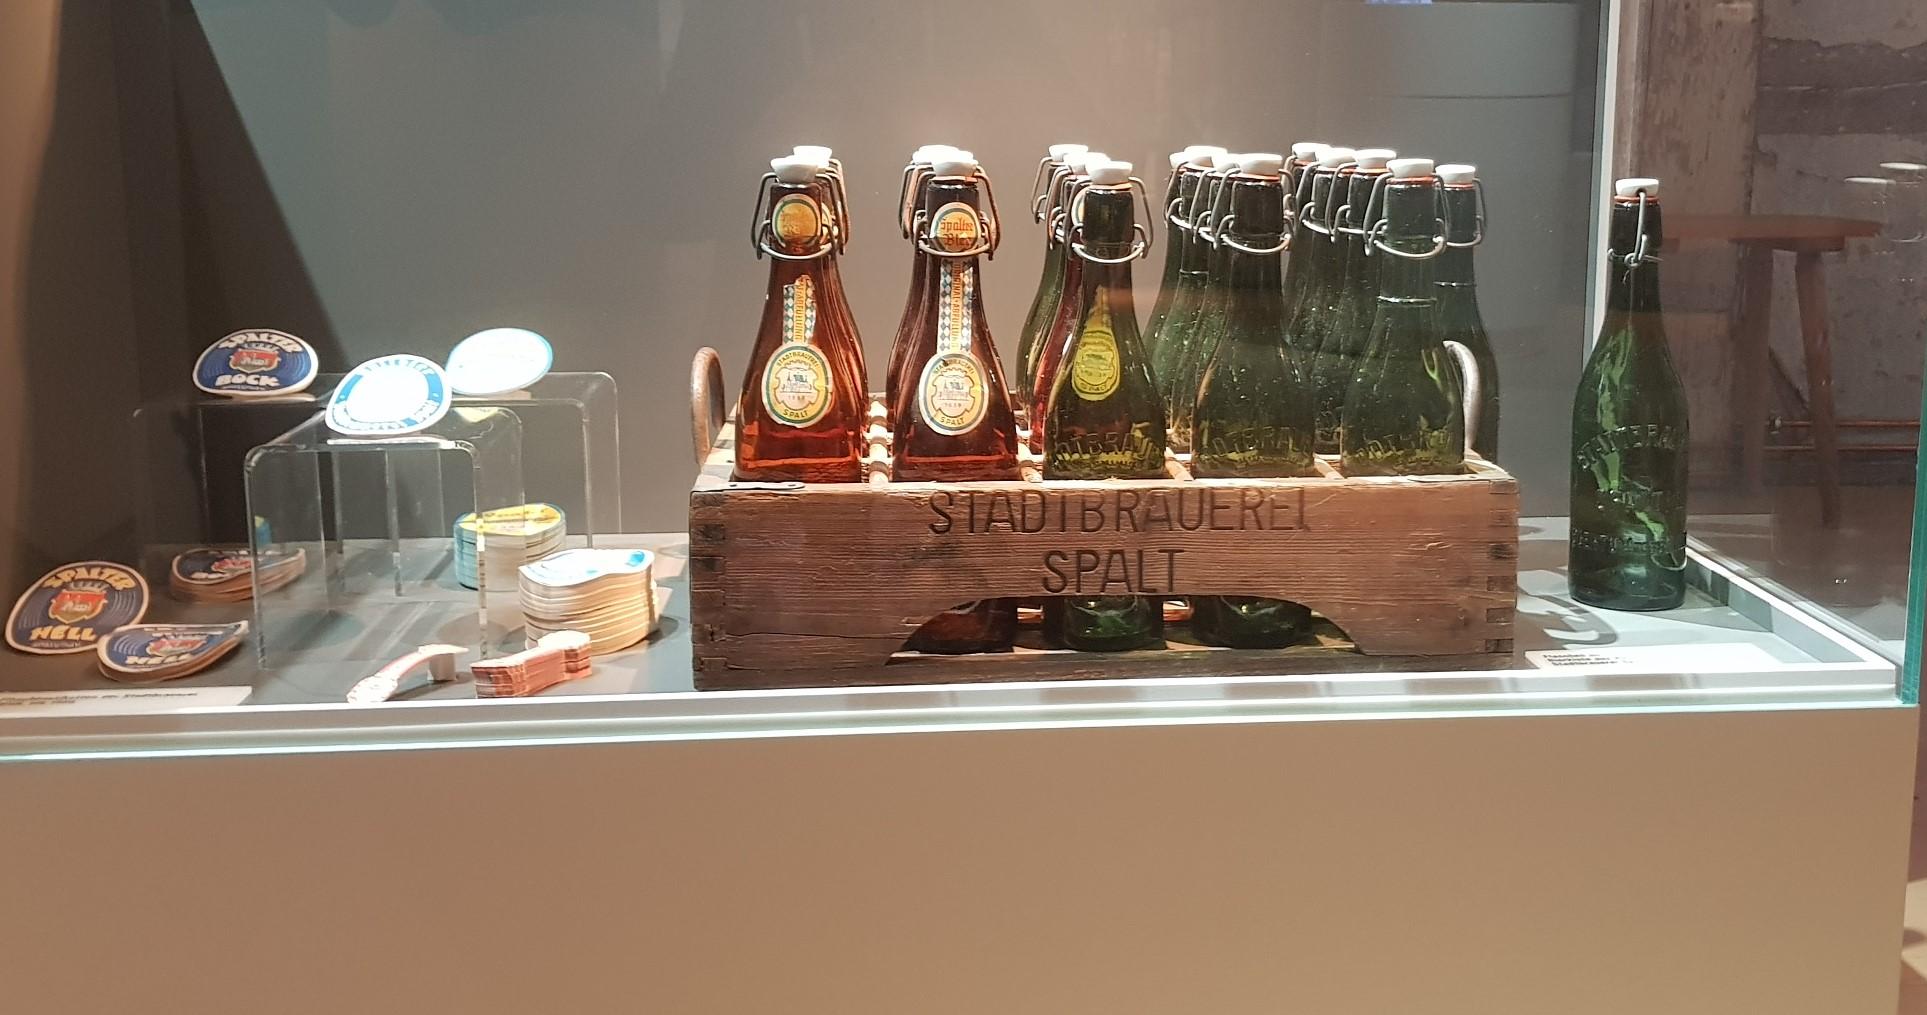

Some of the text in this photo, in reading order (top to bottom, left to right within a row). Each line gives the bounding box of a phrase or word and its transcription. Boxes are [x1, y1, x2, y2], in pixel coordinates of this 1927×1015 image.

[218, 332, 304, 353] SPALTER
[215, 373, 280, 387] BOCK
[783, 409, 808, 419] SPALT
[940, 416, 965, 426] SPALT
[927, 488, 1311, 534] STADTBRAUEREI
[42, 566, 136, 590] SPALTER
[1041, 548, 1186, 595] SPALT
[29, 625, 99, 642] HELL
[125, 652, 195, 666] HELL
